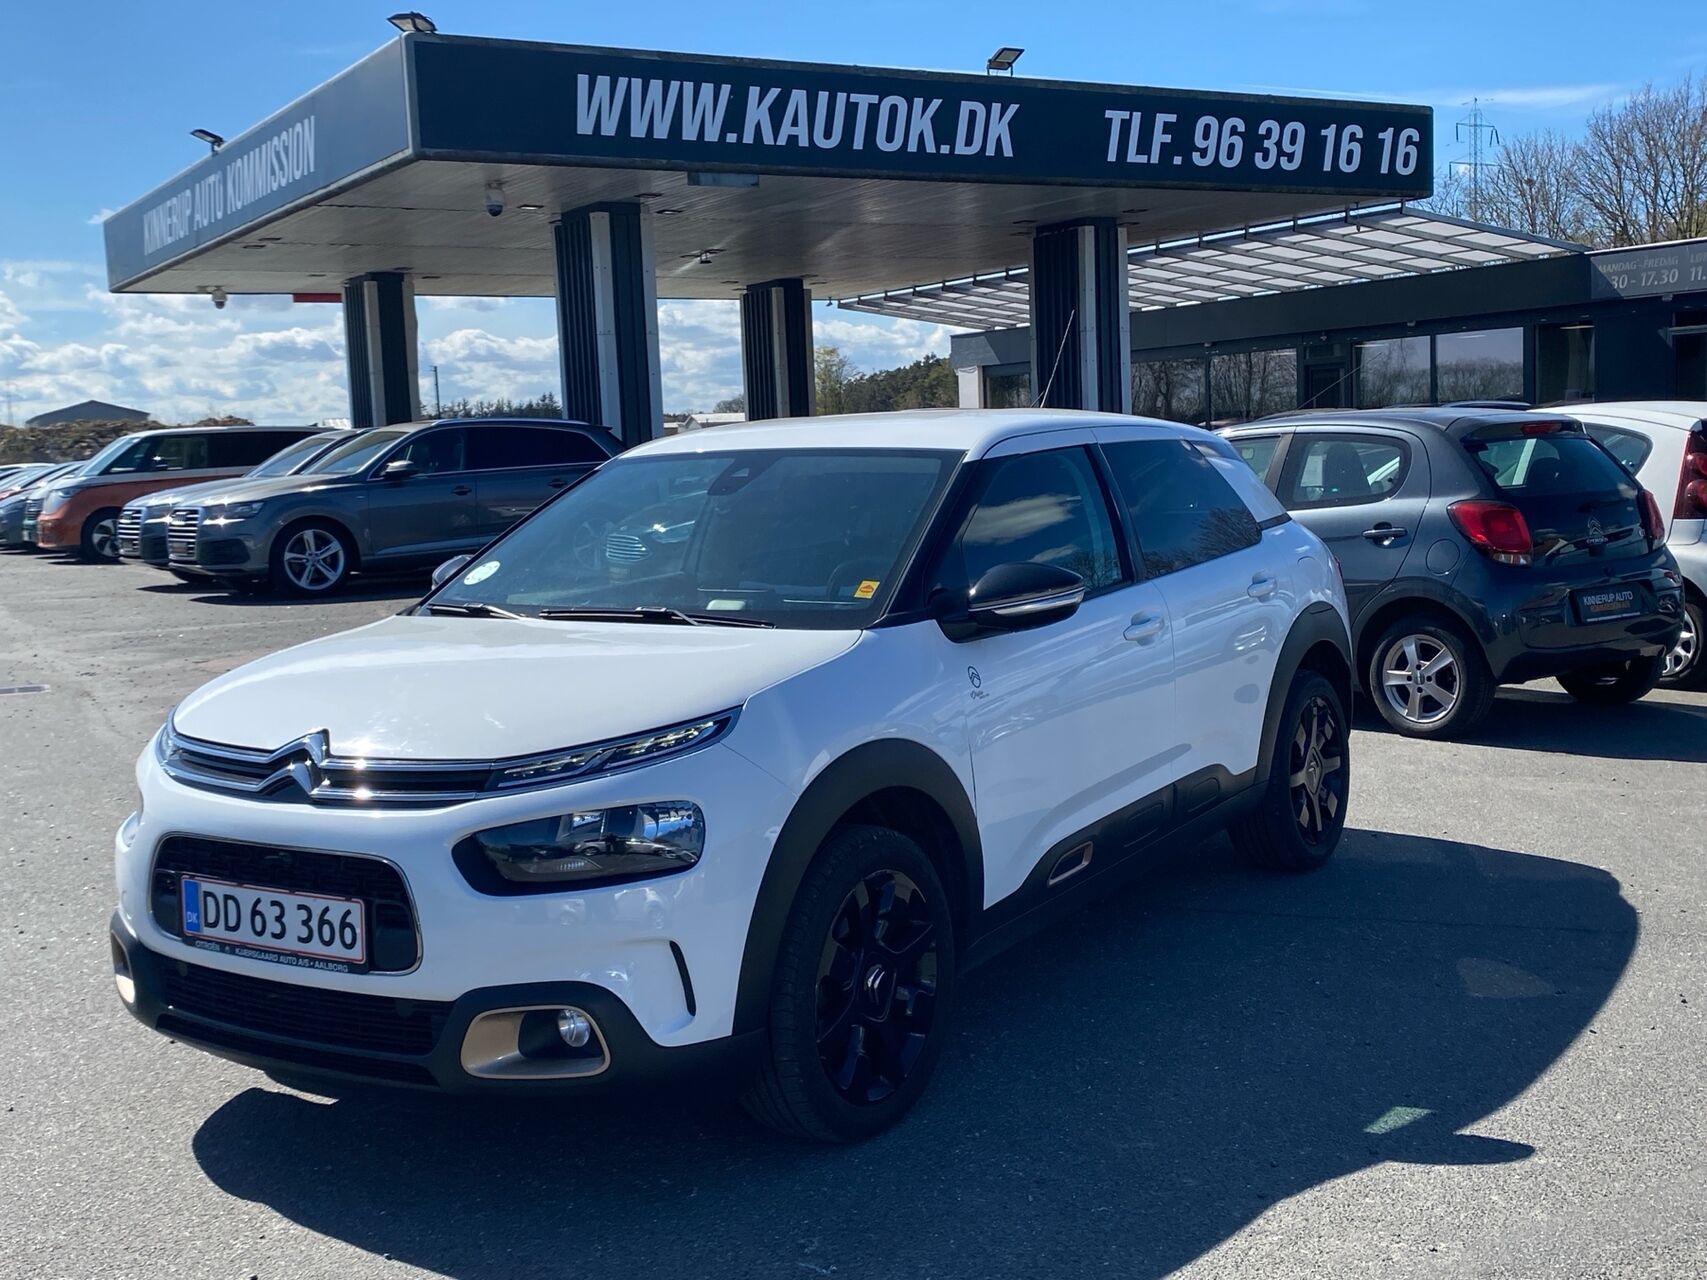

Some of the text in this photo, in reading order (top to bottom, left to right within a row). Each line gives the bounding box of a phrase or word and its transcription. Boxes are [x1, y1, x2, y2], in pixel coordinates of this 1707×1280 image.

[576, 73, 1020, 158] WWW.KAUTOK.DK
[1104, 109, 1420, 176] TLF. 96 39 16 16
[193, 170, 224, 231] AUTO
[226, 115, 316, 215] KOMMISSION
[1641, 268, 1680, 287] 17.30
[1616, 590, 1634, 602] AUTO
[186, 911, 198, 924] DK
[203, 890, 358, 951] DD 63 366
